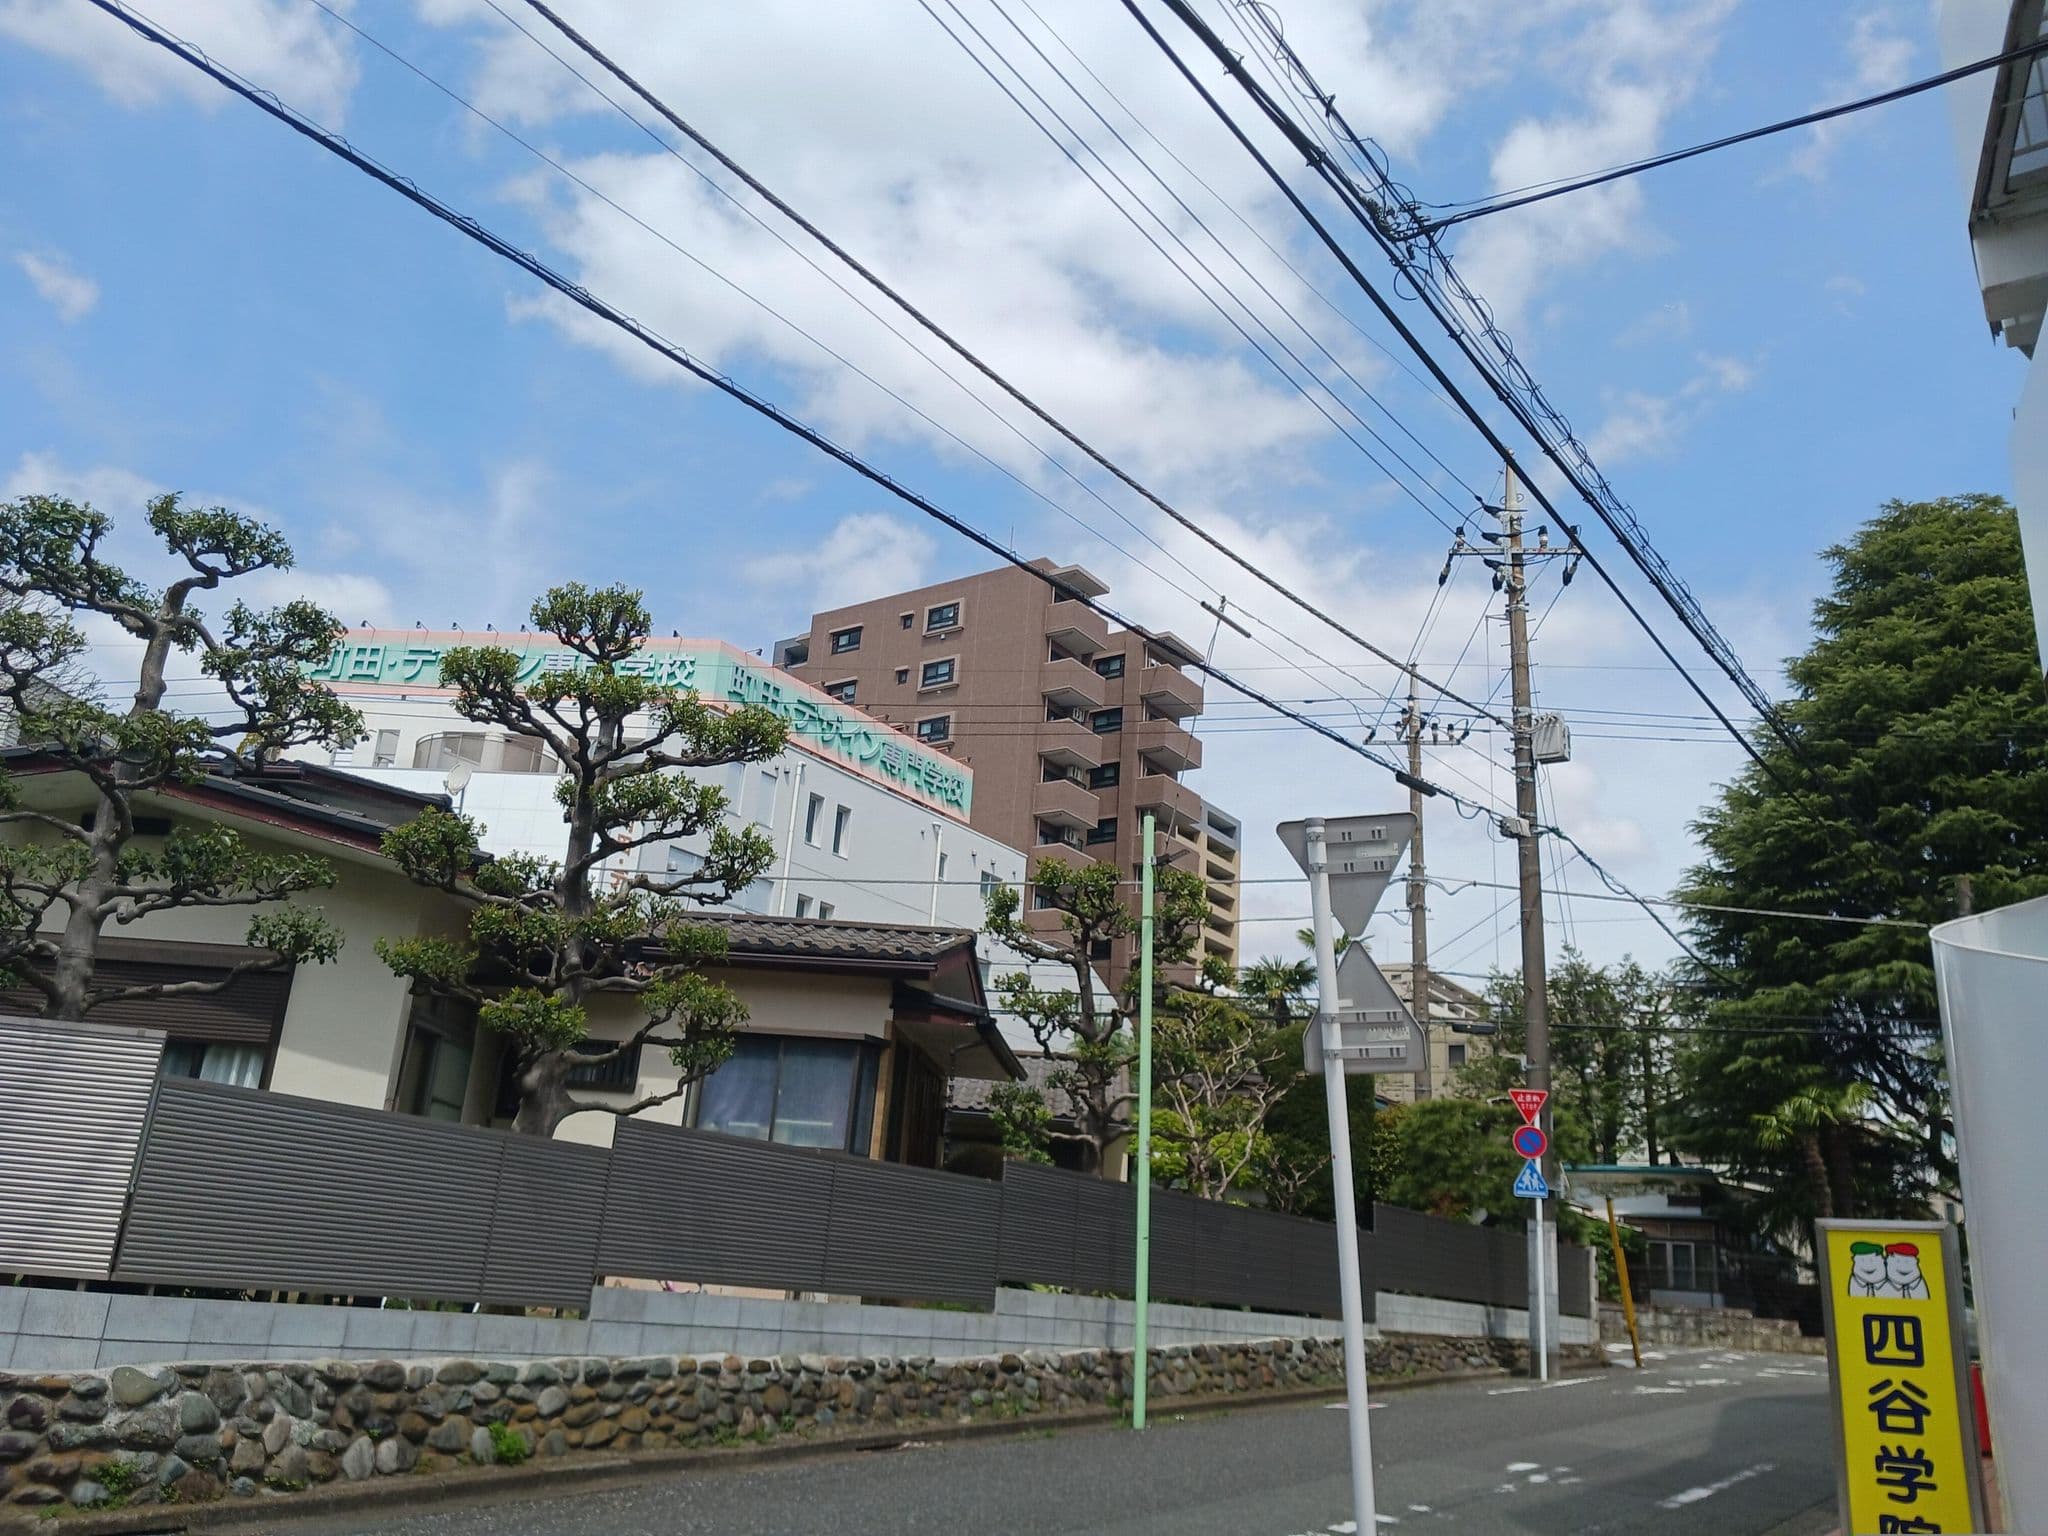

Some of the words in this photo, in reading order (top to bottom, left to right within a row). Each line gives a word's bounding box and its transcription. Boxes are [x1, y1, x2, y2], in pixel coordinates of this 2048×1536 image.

[728, 662, 965, 806] 町田・デザイン専門学校
[1517, 1093, 1541, 1102] 止まれ
[1520, 1102, 1537, 1110] STOP
